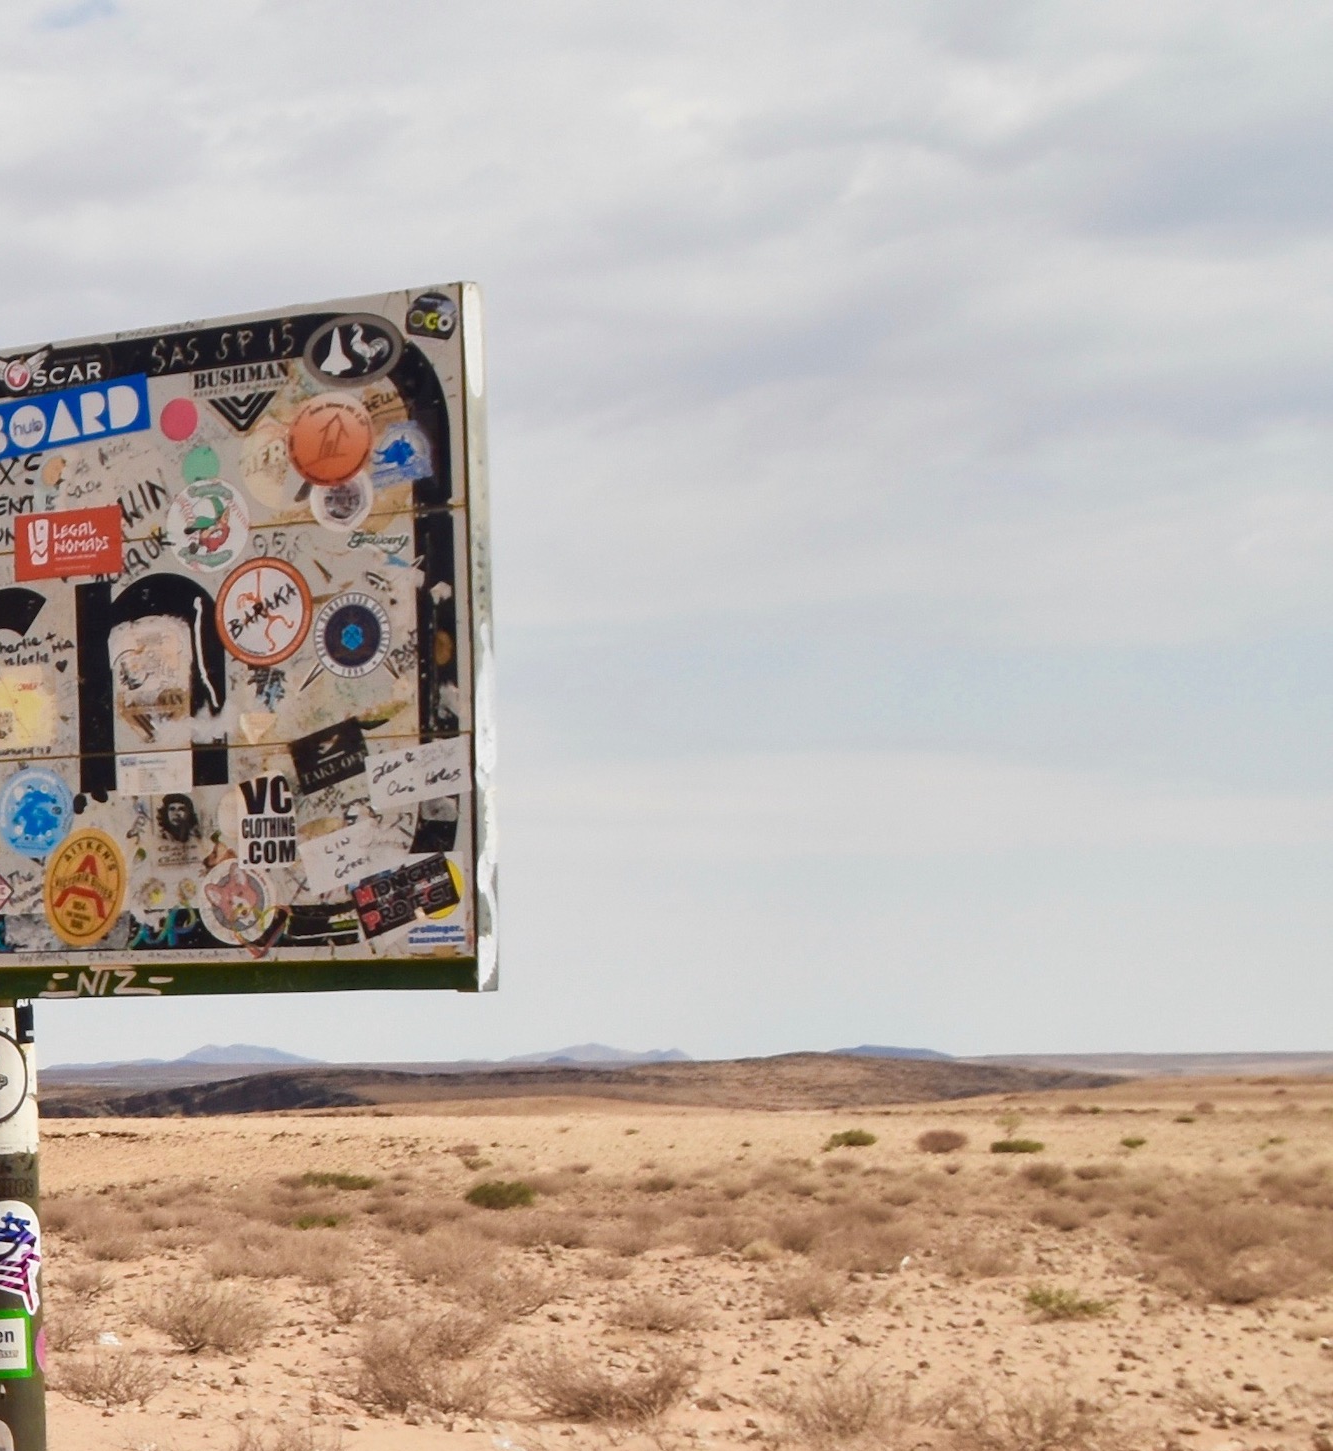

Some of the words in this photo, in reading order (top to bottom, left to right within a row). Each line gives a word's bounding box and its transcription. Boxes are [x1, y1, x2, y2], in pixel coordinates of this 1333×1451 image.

[193, 362, 288, 389] BUSHMAN
[12, 420, 43, 437] hub
[52, 520, 98, 540] LEGAL
[54, 535, 110, 555] NOMADS
[229, 582, 297, 641] BARAKA
[239, 775, 293, 816] VC
[242, 816, 296, 839] CLOTHING
[242, 840, 296, 865] .COM
